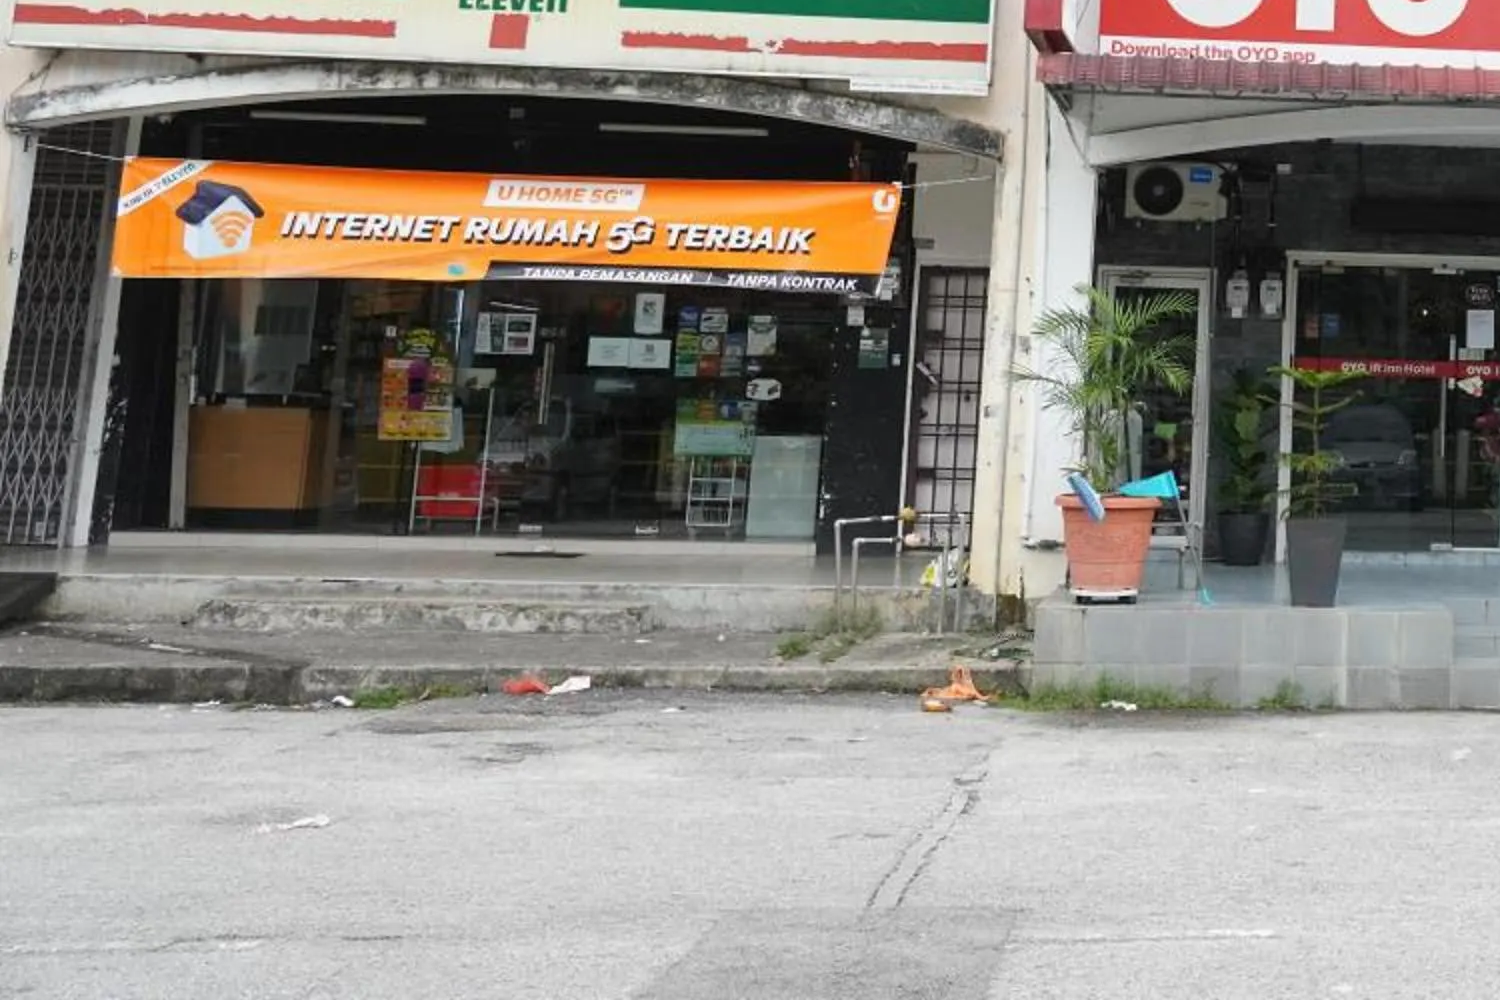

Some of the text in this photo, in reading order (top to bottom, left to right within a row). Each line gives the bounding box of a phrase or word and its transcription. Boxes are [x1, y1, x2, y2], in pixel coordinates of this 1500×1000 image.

[1111, 39, 1316, 63] Download the OYO app
[498, 185, 513, 200] U
[518, 185, 588, 202] HOME
[281, 211, 816, 253] INTERNET RUMAH 5G TERBAIK
[727, 273, 778, 288] TANPA
[780, 275, 858, 291] KONTRAK
[1341, 361, 1367, 372] OYO
[1403, 364, 1436, 375] Hotel
[1466, 365, 1492, 376] OYO
